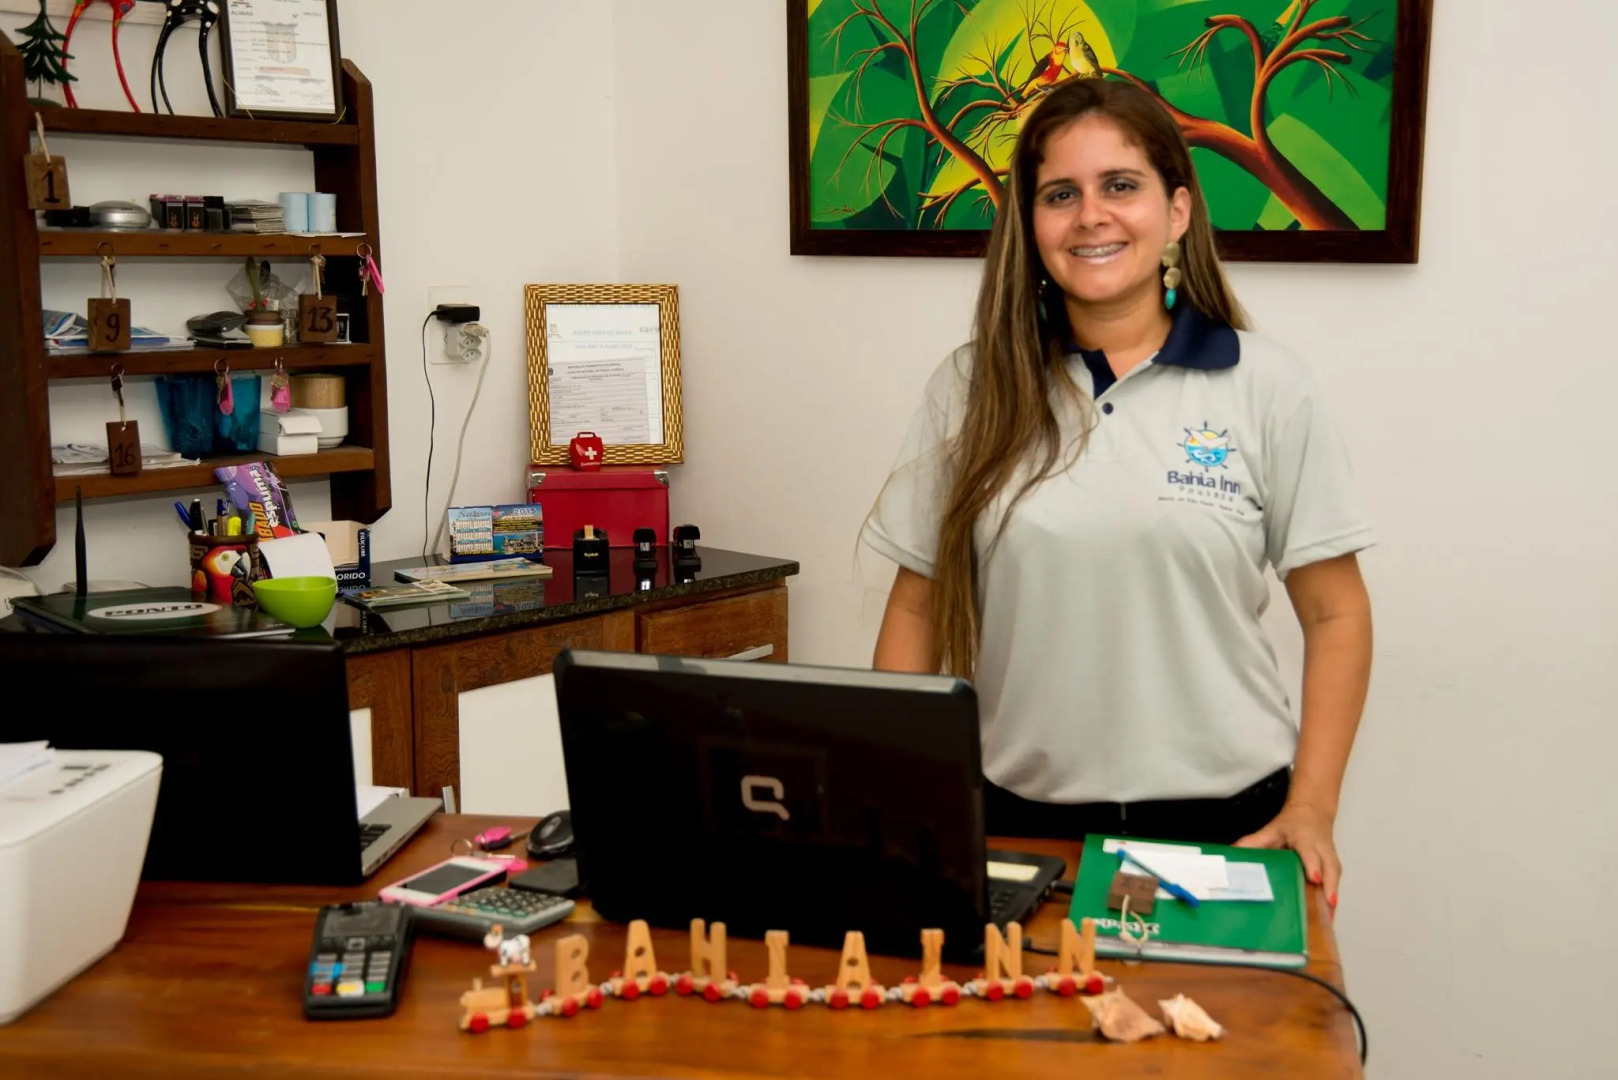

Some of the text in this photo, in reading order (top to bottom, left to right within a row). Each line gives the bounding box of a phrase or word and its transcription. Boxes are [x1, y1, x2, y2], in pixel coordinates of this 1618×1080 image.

[42, 170, 61, 203] 1
[106, 313, 120, 342] 9
[307, 306, 333, 333] 13
[115, 442, 136, 468] 16
[1167, 470, 1241, 494] Bahia Inn
[250, 469, 280, 528] espuma
[512, 507, 537, 515] 2015
